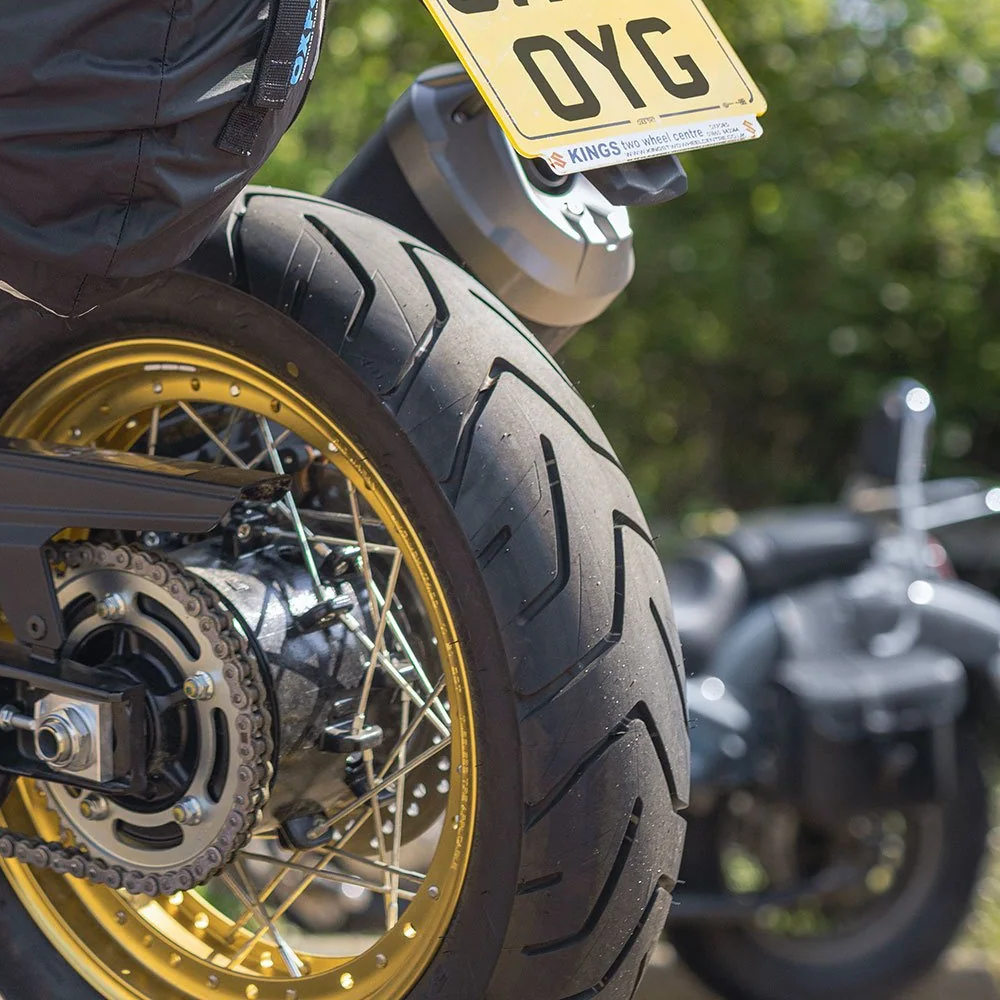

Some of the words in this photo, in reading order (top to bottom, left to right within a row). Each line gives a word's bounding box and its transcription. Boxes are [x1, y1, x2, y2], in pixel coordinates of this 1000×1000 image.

[513, 17, 710, 121] OYG
[567, 141, 621, 164] KINGS
[621, 140, 640, 151] two
[642, 132, 672, 146] wheel
[673, 128, 704, 141] centre
